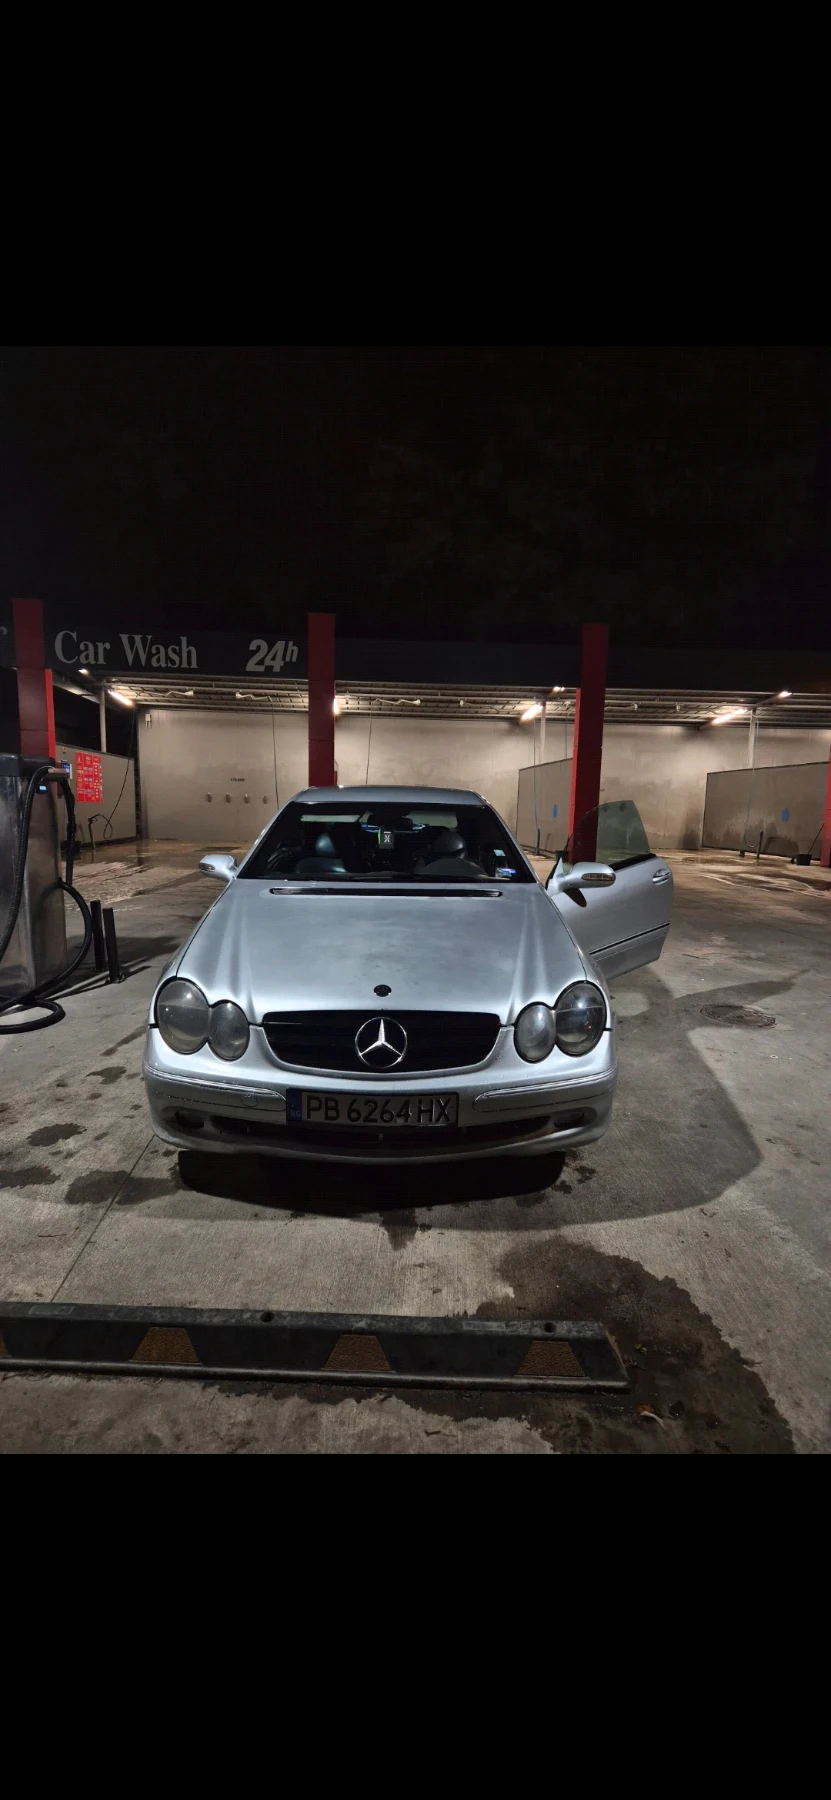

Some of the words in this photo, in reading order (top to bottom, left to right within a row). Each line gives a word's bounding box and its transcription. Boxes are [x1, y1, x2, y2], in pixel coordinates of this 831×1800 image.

[54, 630, 111, 665] Car
[119, 633, 199, 668] Wash
[245, 639, 299, 672] 24h
[306, 1095, 341, 1121] PB
[346, 1098, 411, 1123] 6264
[417, 1098, 451, 1123] HX
